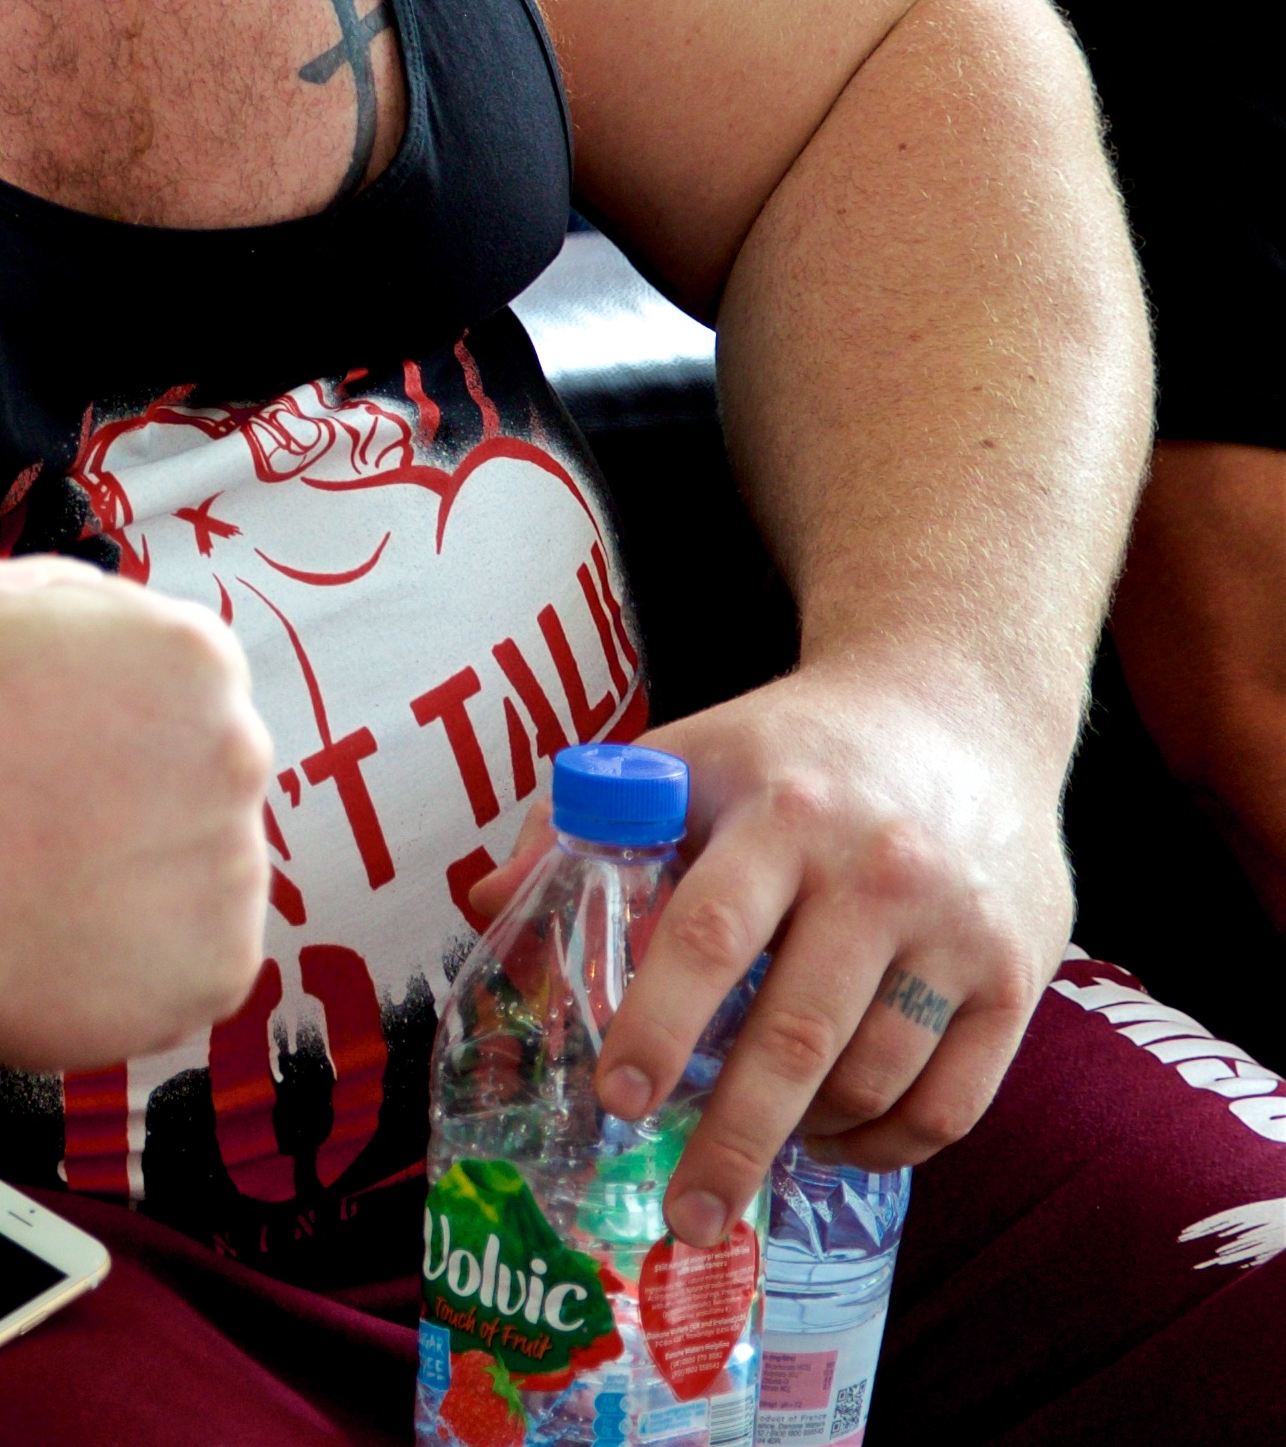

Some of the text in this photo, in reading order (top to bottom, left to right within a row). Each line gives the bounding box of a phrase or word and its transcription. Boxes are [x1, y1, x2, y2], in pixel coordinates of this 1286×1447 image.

[422, 1205, 588, 1332] Volvic
[435, 1295, 552, 1361] Touch of Fruit
